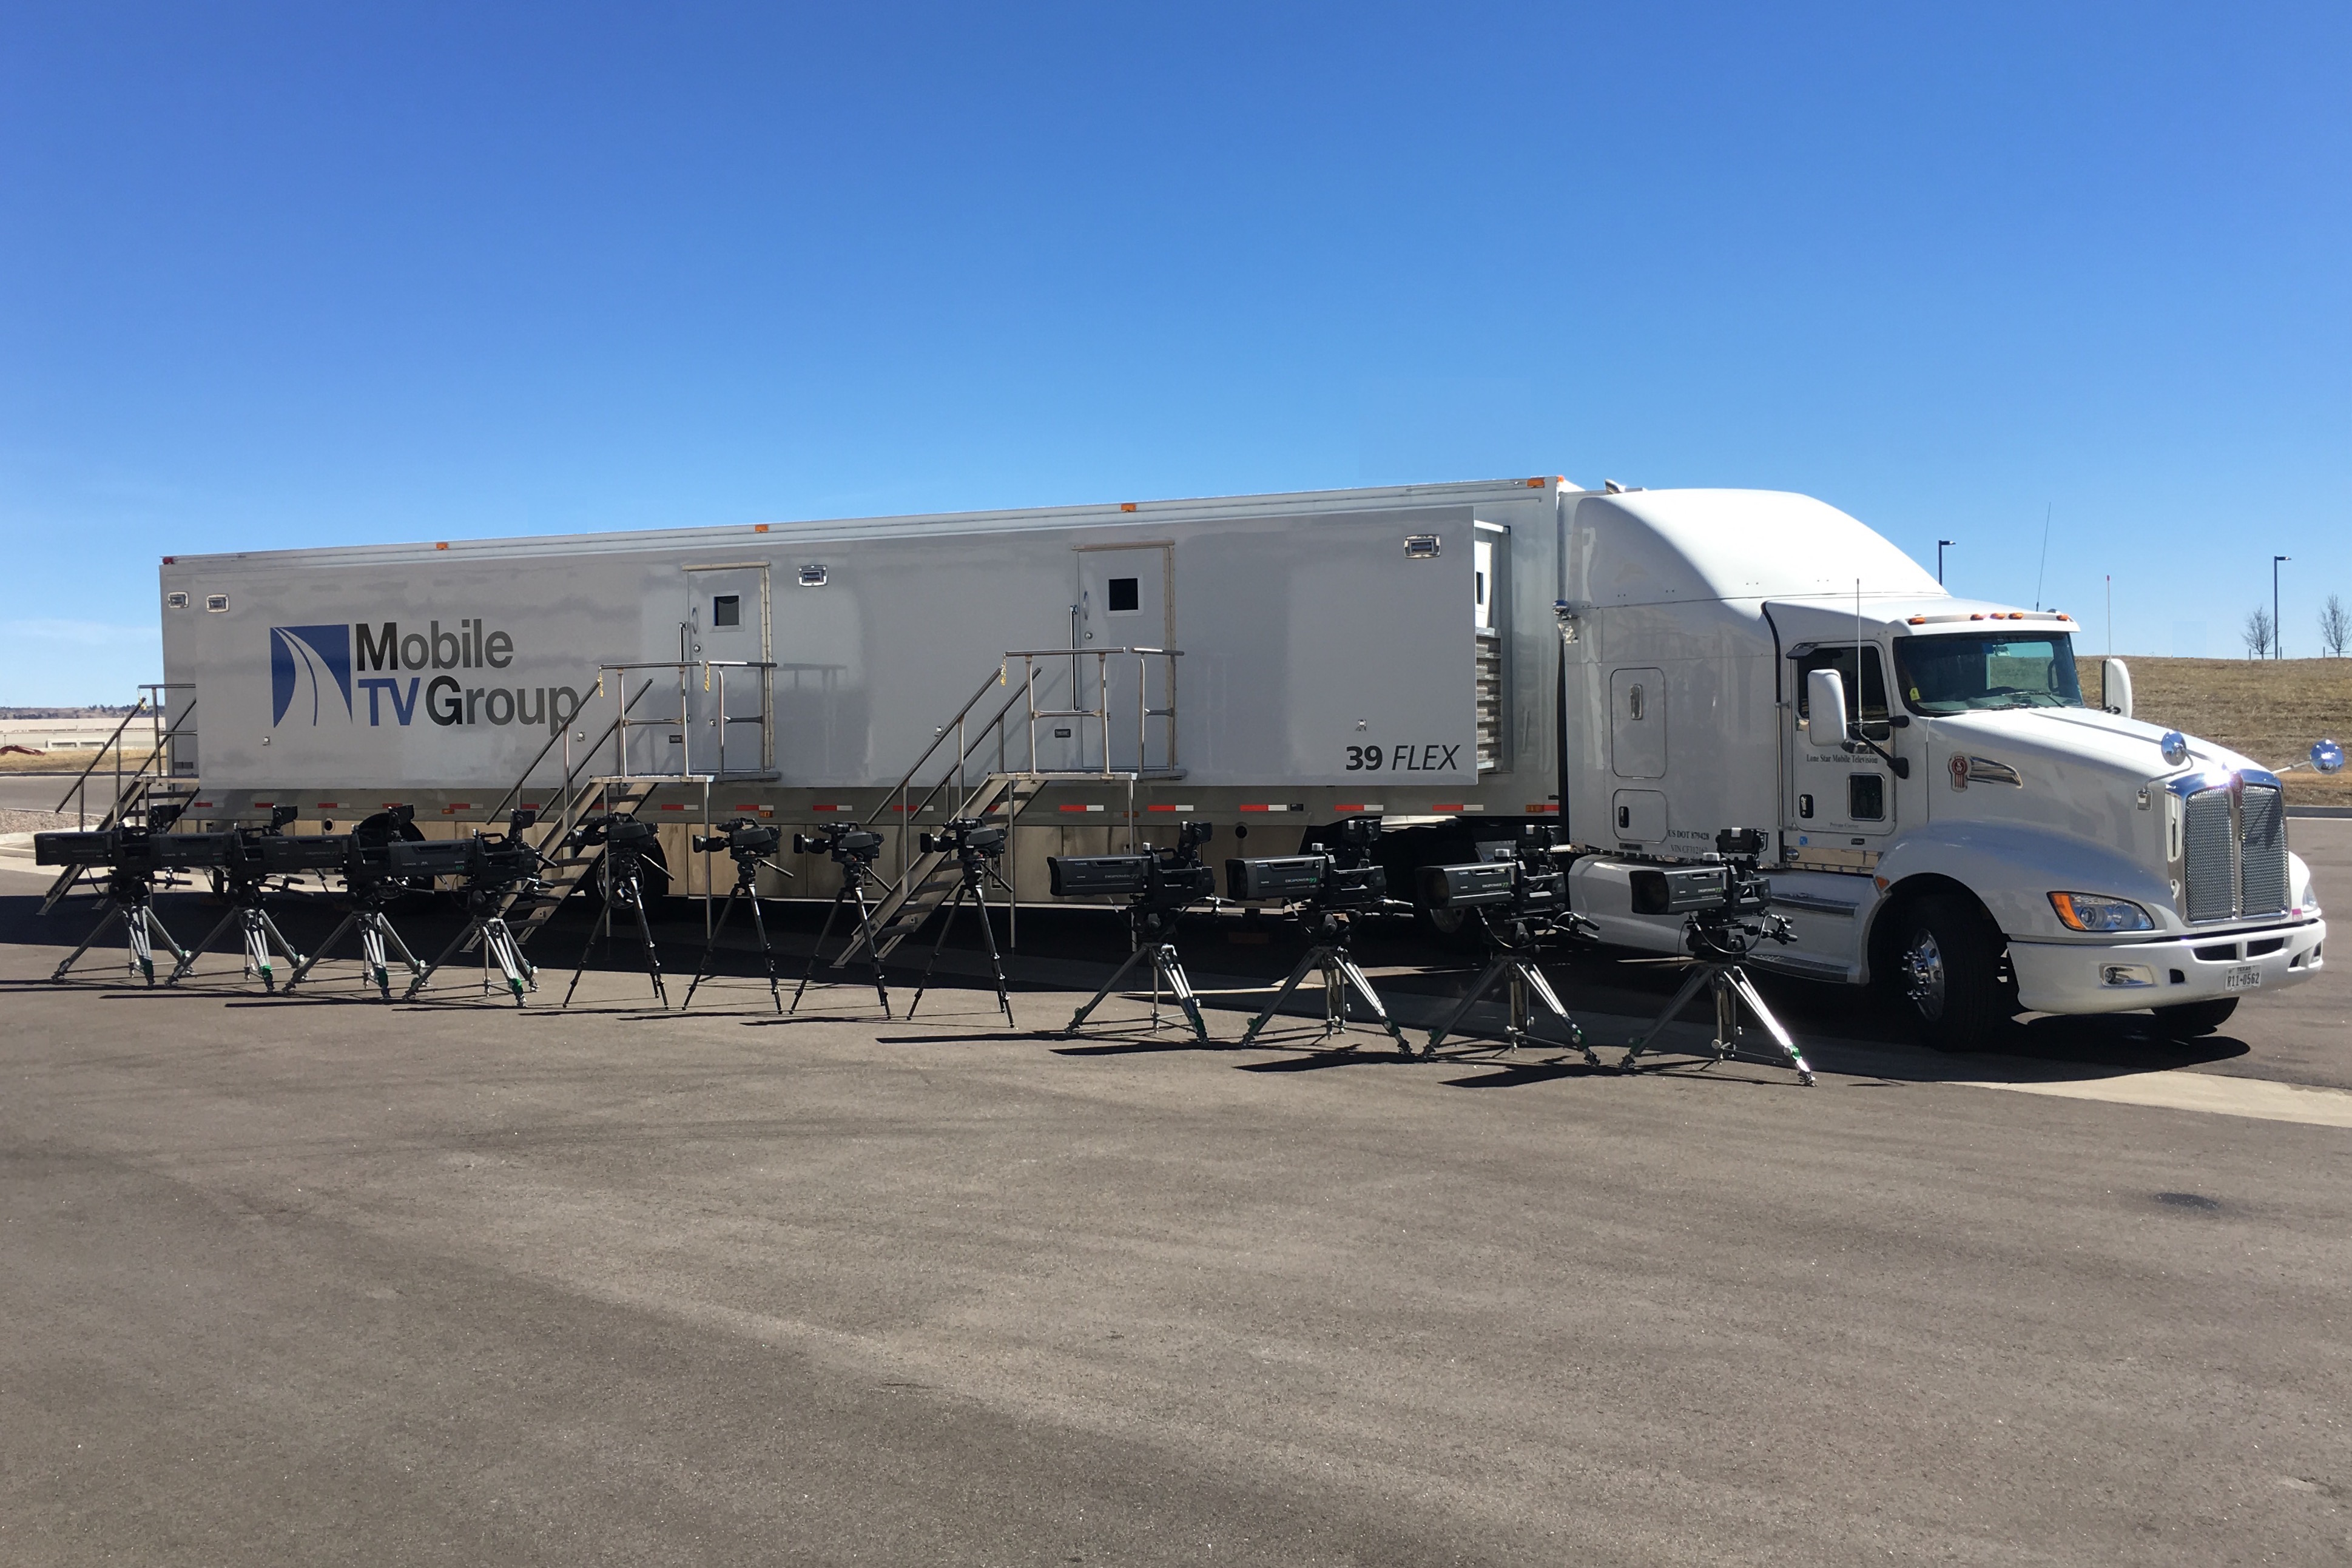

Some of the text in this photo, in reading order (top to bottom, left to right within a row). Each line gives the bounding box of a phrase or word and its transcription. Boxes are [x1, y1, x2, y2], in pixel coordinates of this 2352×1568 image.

[356, 619, 514, 671] Mobile
[357, 675, 579, 736] TV Group
[1346, 744, 1461, 771] 39 FLEX
[1807, 754, 1878, 764] Lone Star Mobile Television
[1677, 830, 1690, 838] DOT
[1670, 844, 1681, 852] VIN
